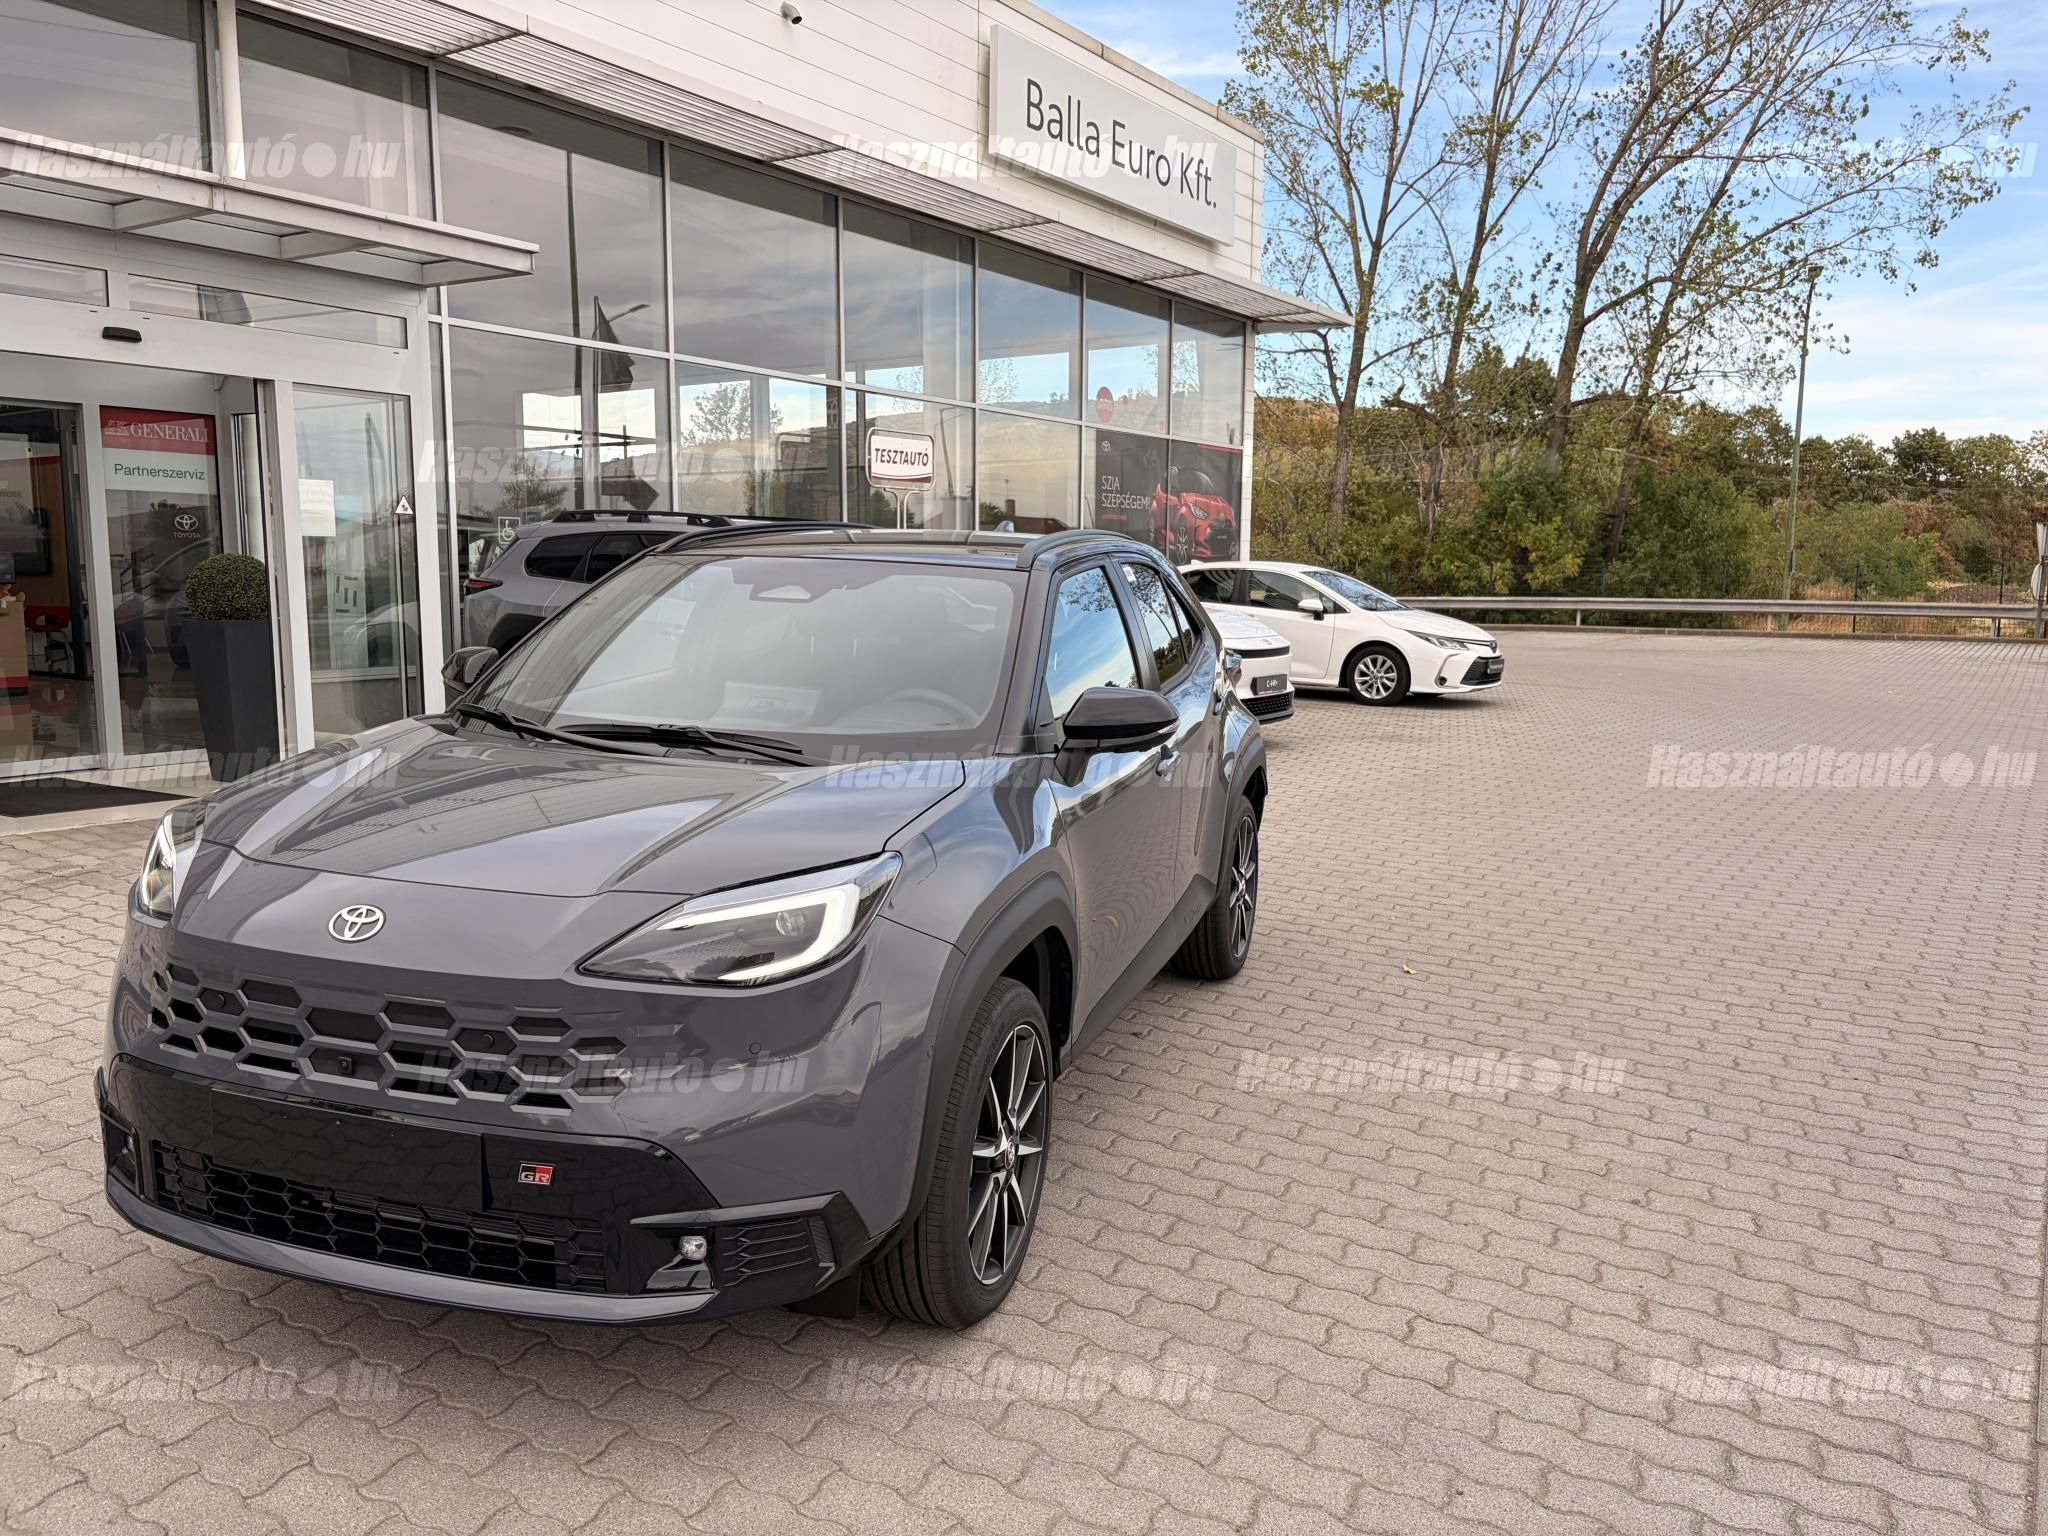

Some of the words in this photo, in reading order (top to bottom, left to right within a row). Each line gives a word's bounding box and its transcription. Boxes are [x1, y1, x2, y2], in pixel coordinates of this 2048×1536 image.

[1026, 78, 1100, 158] Balla
[1111, 119, 1171, 187] Euro
[1180, 152, 1217, 208] Kft.
[130, 422, 209, 443] GENERALI
[875, 447, 929, 467] TESZTAUTÓ
[114, 463, 206, 481] Partnerszerviz
[1101, 475, 1120, 491] SZIA
[520, 1171, 550, 1183] GR
